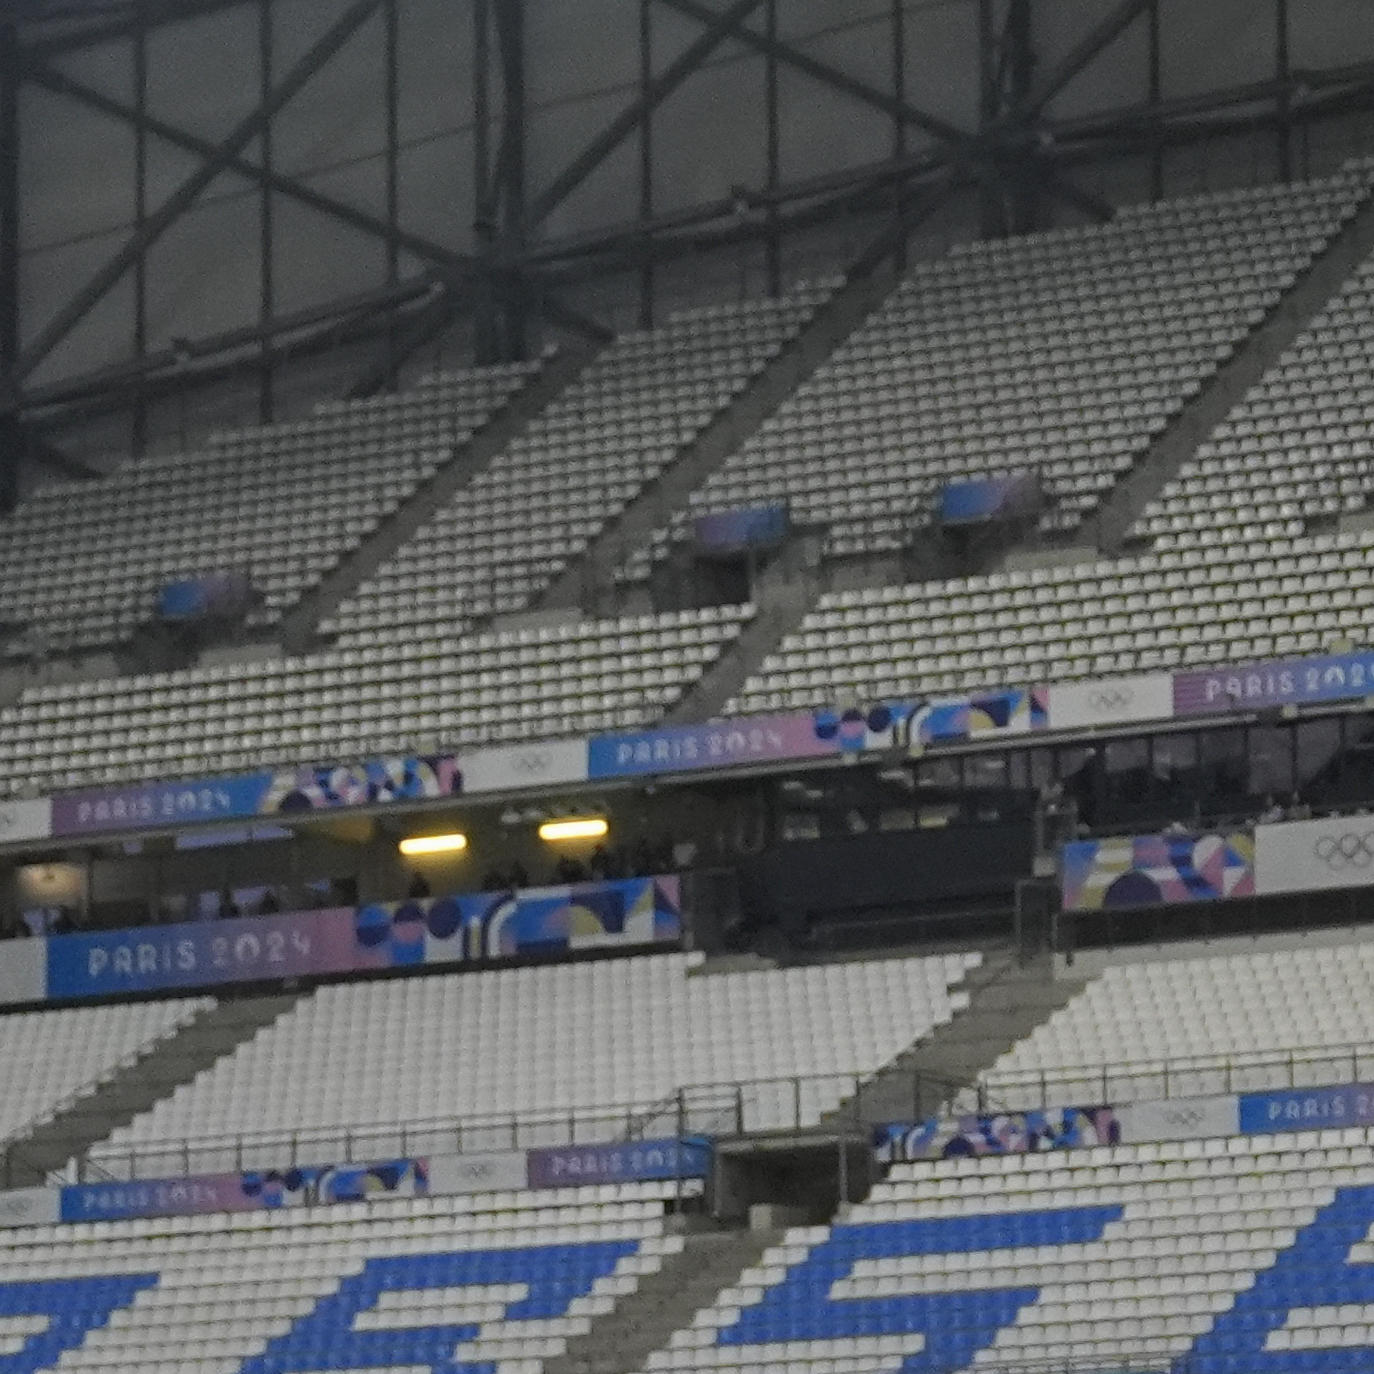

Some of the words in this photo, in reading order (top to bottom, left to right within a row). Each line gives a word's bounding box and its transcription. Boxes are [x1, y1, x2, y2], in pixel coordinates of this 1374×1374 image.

[1205, 672, 1296, 701] PARIS
[617, 735, 699, 766] PARIS
[708, 728, 782, 757] 2024
[78, 799, 154, 824] PARIS
[161, 787, 231, 816] 2024
[87, 940, 197, 978] PARIS
[211, 930, 311, 968] 2024
[1267, 1096, 1345, 1121] PARIS
